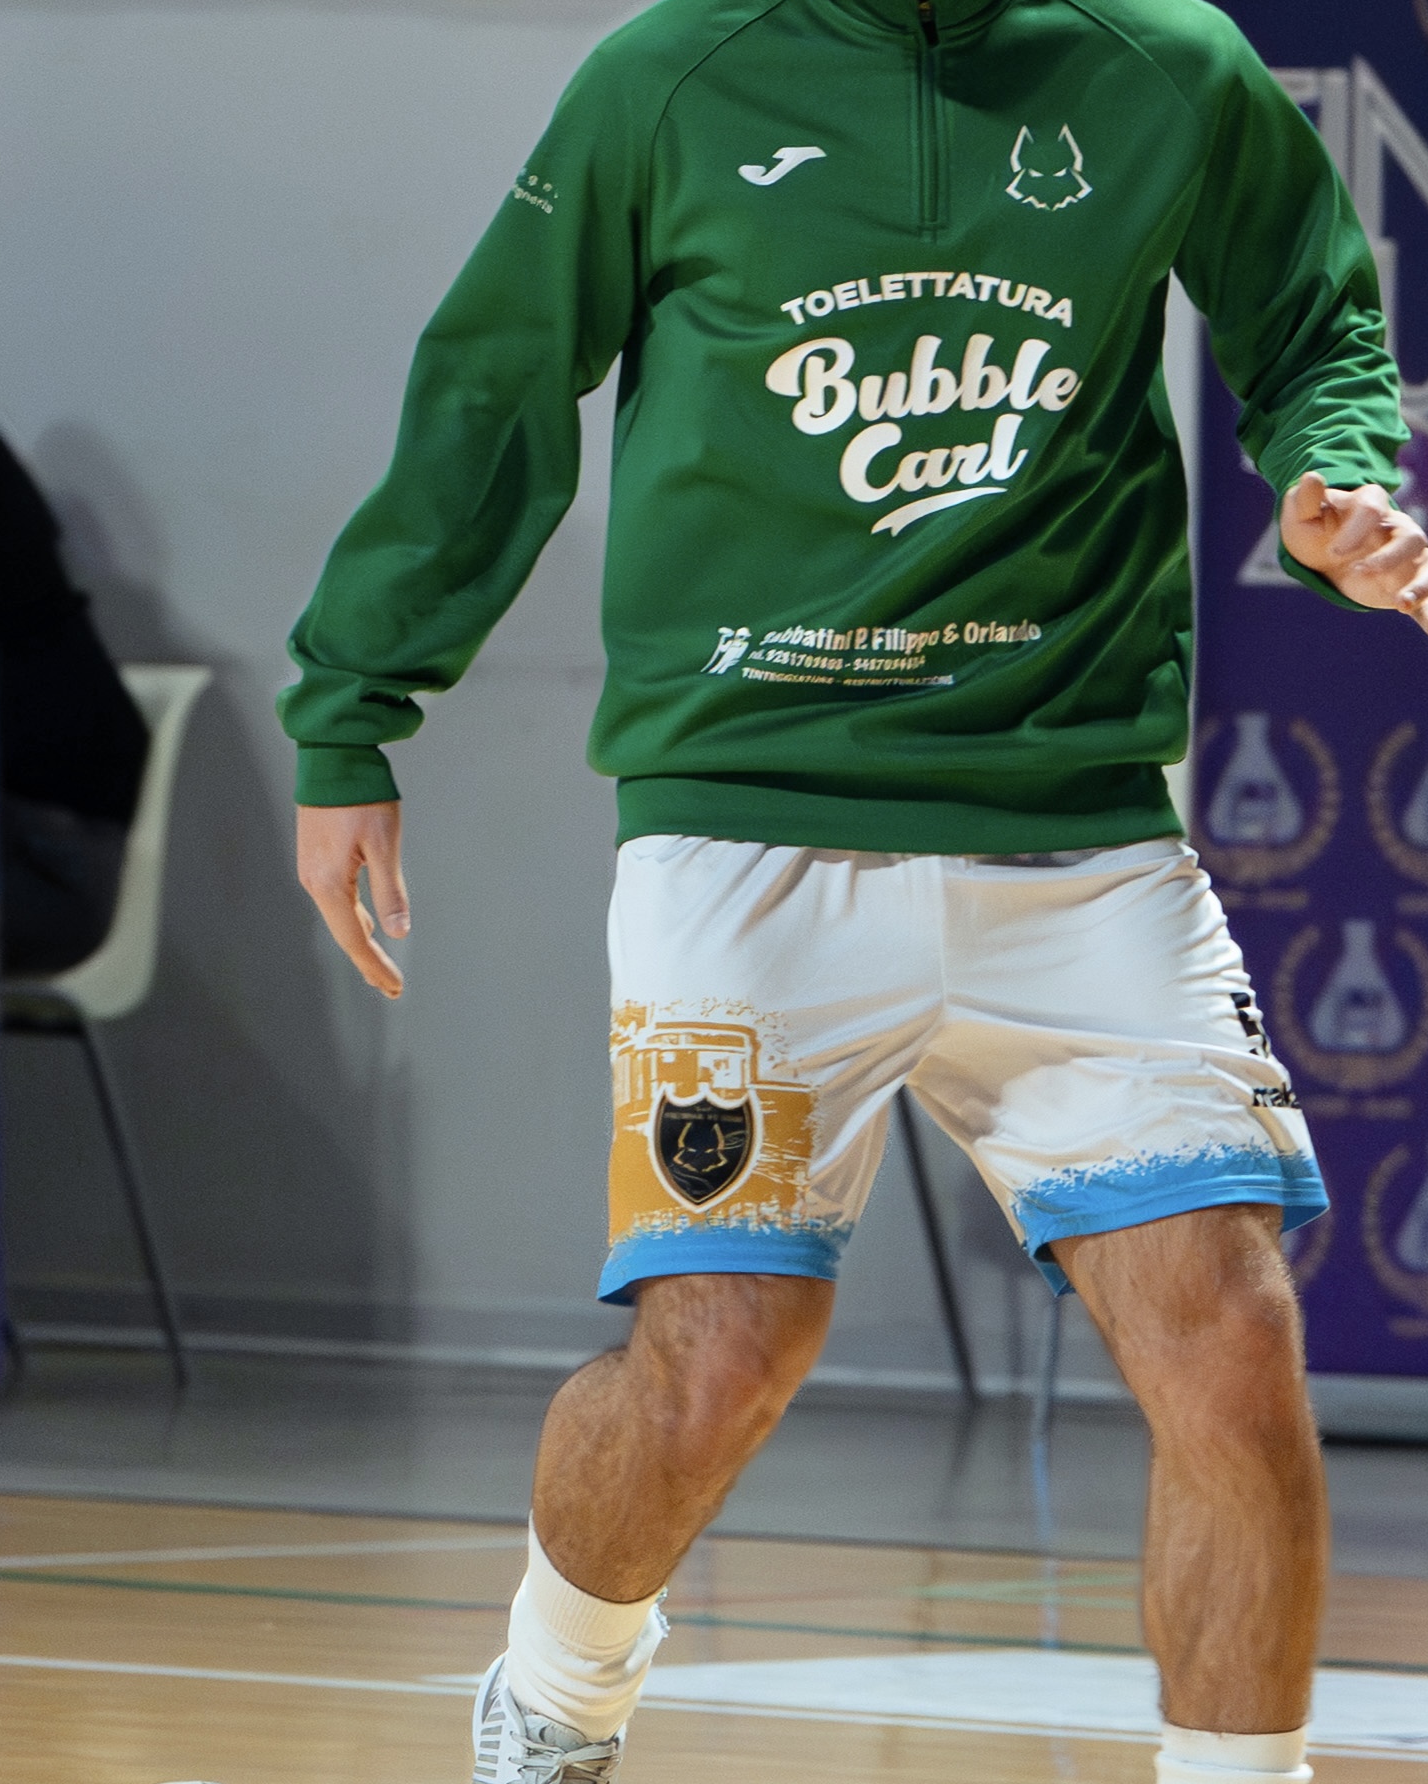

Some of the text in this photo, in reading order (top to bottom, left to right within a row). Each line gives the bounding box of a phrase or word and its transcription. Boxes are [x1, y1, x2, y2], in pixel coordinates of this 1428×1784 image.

[780, 272, 1072, 328] TOELETTATURA
[765, 333, 1083, 435] Bubble
[839, 413, 1029, 503] Carl
[870, 627, 940, 655] Filippo
[942, 623, 960, 645] &
